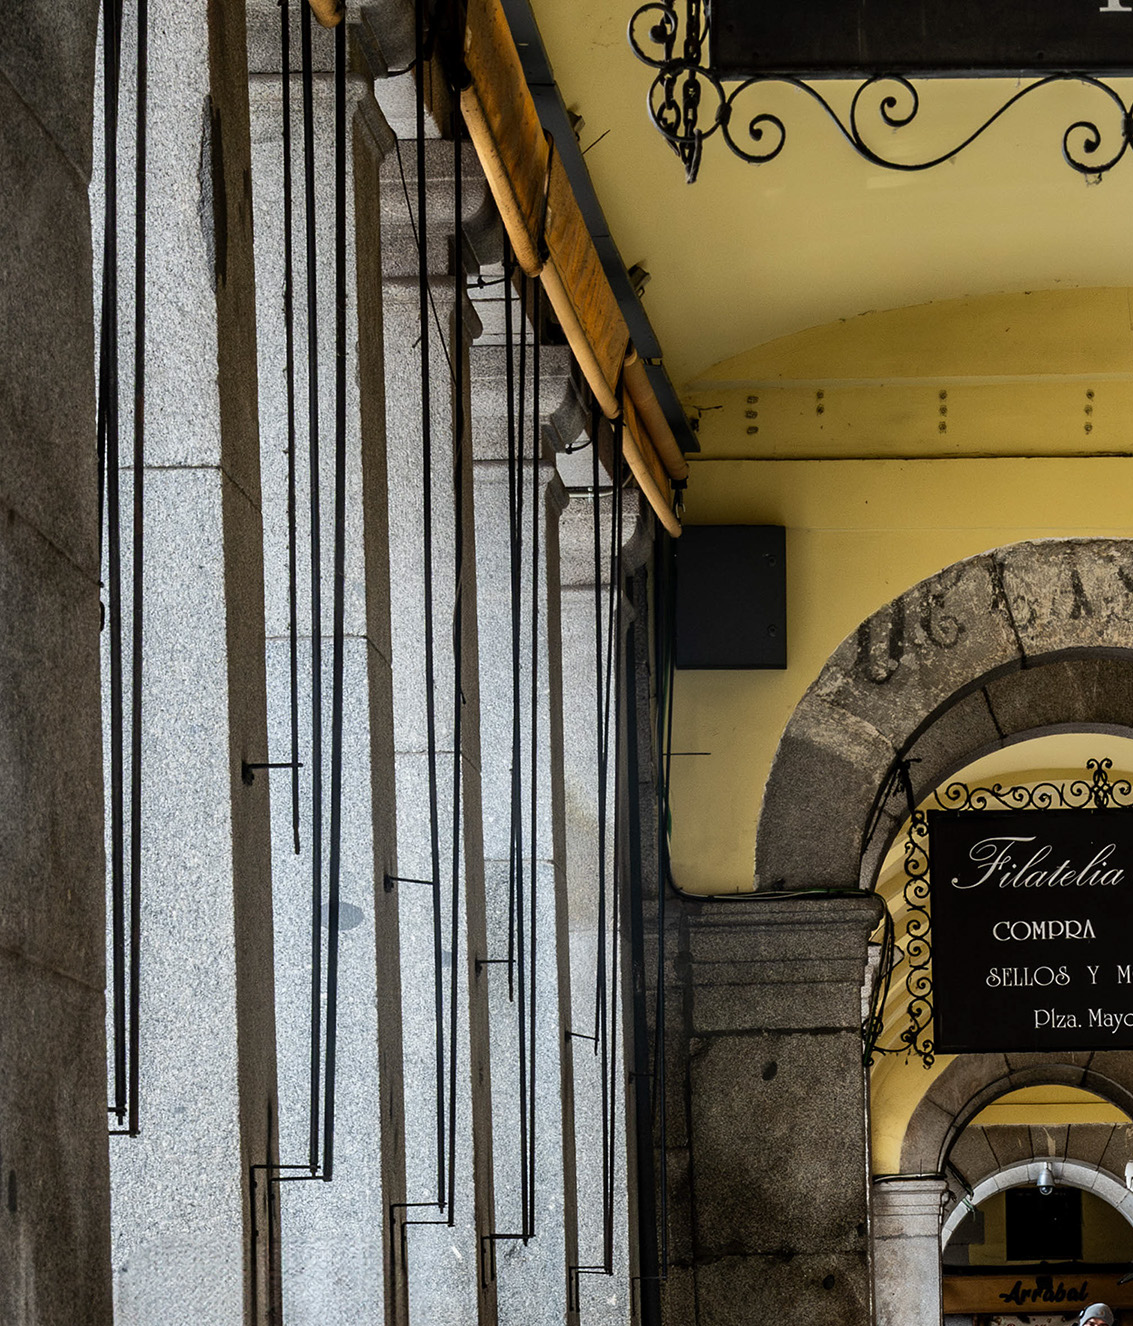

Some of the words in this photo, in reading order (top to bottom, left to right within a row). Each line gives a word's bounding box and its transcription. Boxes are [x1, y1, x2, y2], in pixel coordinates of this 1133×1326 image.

[951, 835, 1125, 889] Filatelia
[993, 920, 1096, 942] COMPRA
[986, 966, 1070, 988] SELLOS
[1087, 965, 1100, 985] Y
[1034, 1008, 1082, 1029] Plza.
[999, 1280, 1088, 1305] Arrabal
